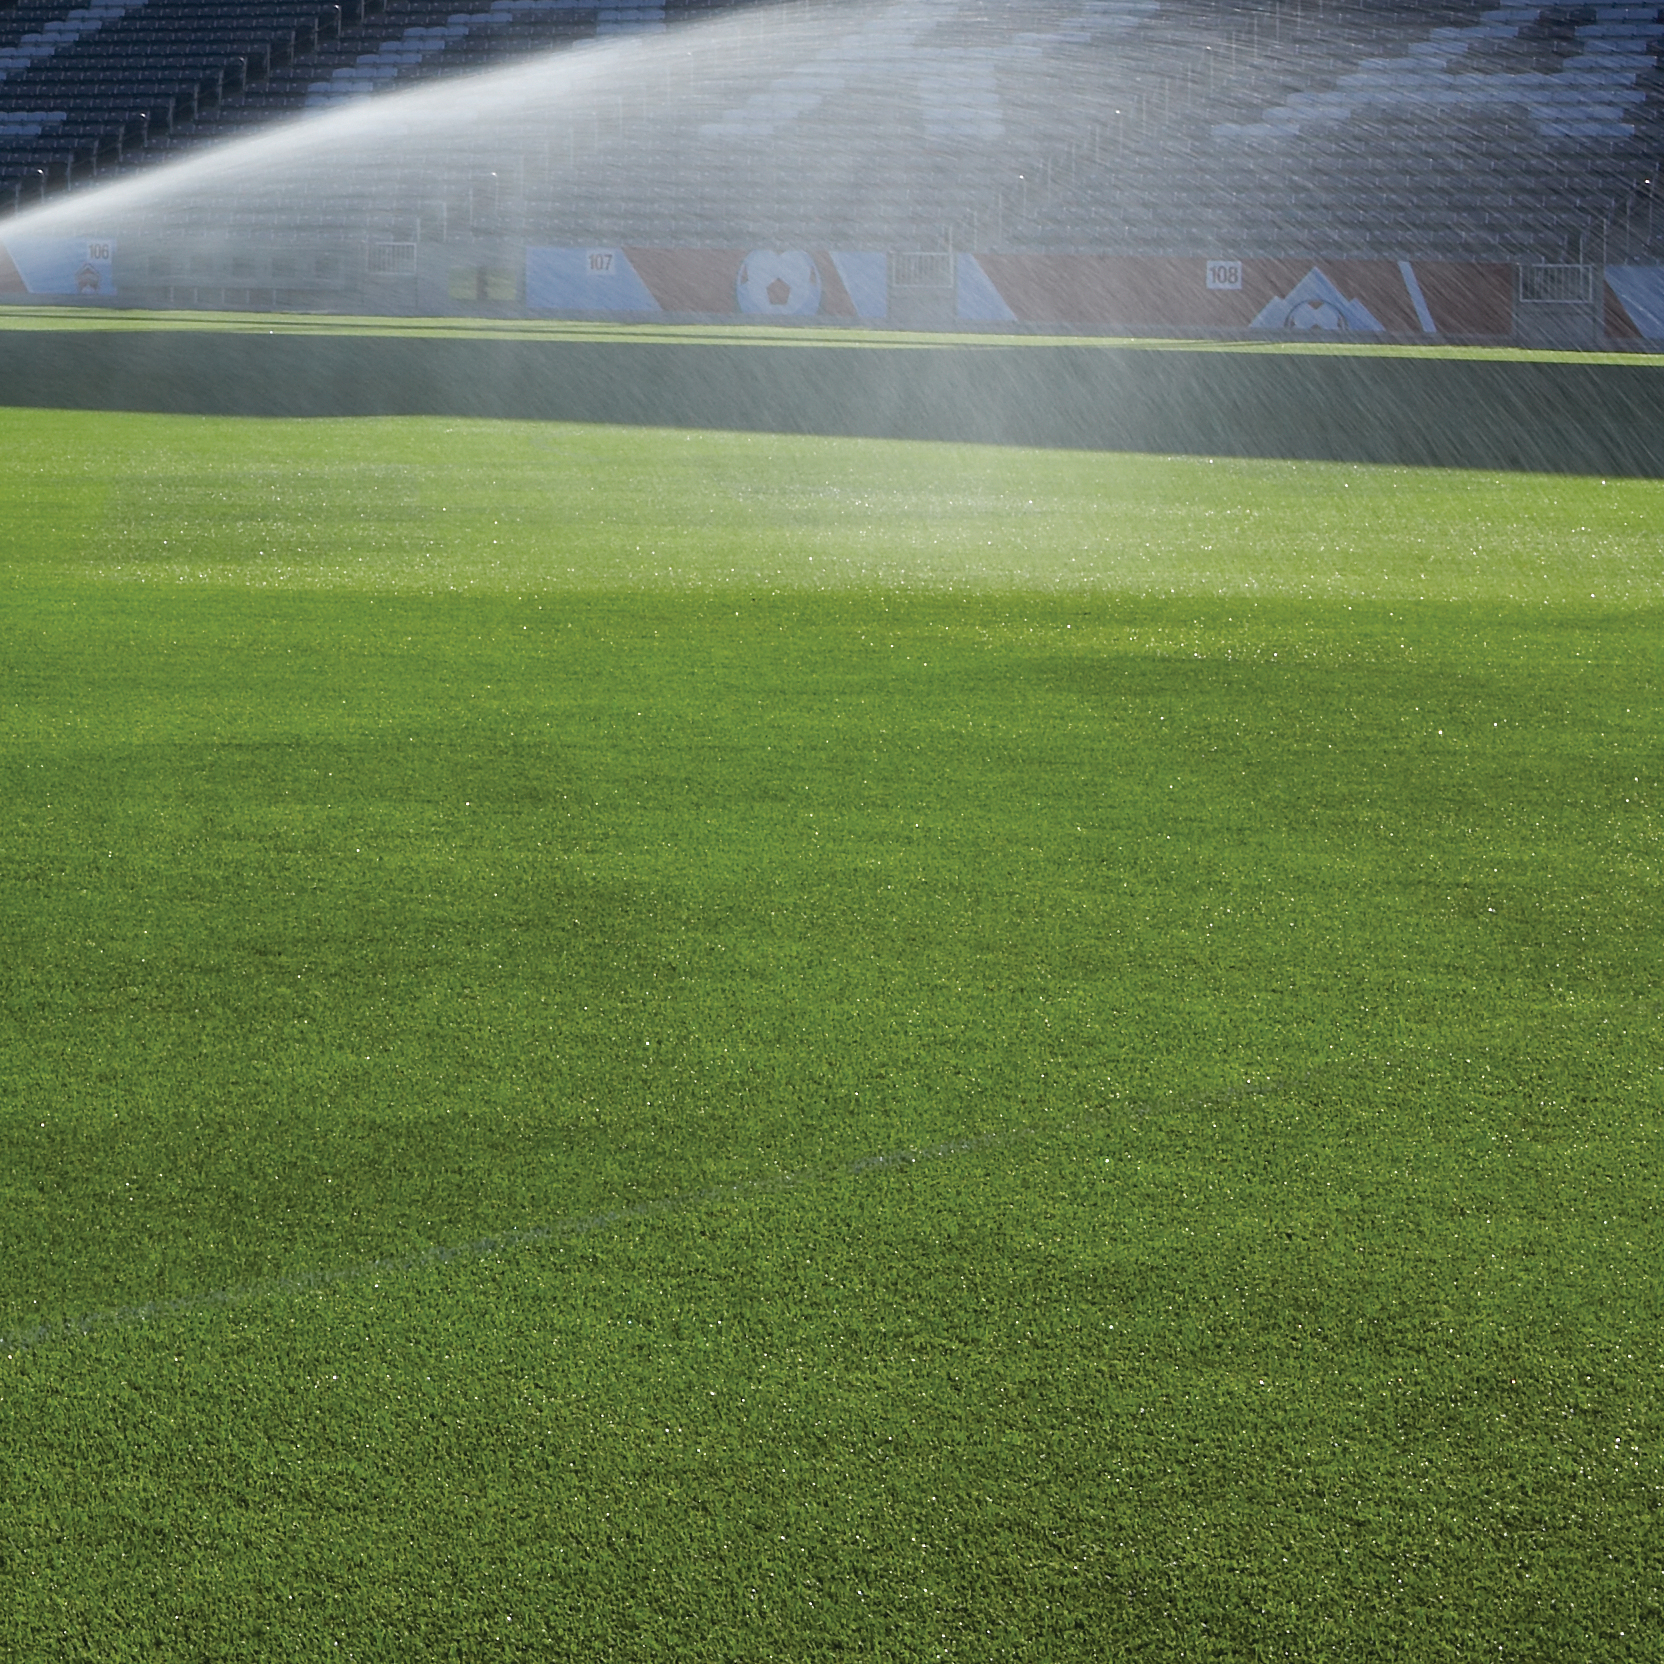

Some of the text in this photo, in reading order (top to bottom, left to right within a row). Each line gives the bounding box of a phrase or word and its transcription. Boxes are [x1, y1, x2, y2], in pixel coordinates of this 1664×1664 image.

[88, 243, 109, 259] 106
[588, 253, 613, 271] 107
[1209, 265, 1239, 284] 108
